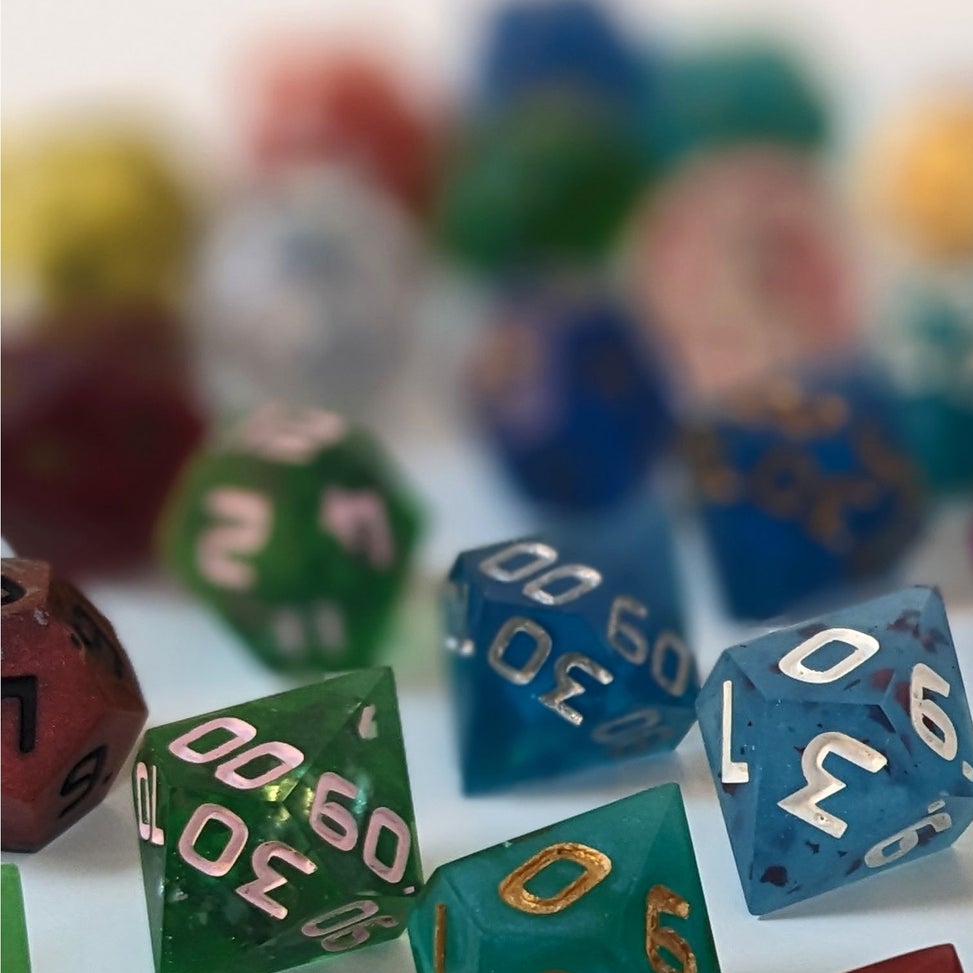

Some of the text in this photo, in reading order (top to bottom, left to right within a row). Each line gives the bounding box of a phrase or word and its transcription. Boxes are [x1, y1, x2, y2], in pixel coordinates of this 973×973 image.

[478, 541, 602, 606] 00
[606, 594, 696, 697] 60
[778, 627, 880, 684] 0
[168, 716, 306, 790] 00
[721, 679, 749, 784] 1
[776, 731, 888, 840] 3
[498, 841, 613, 915] 0
